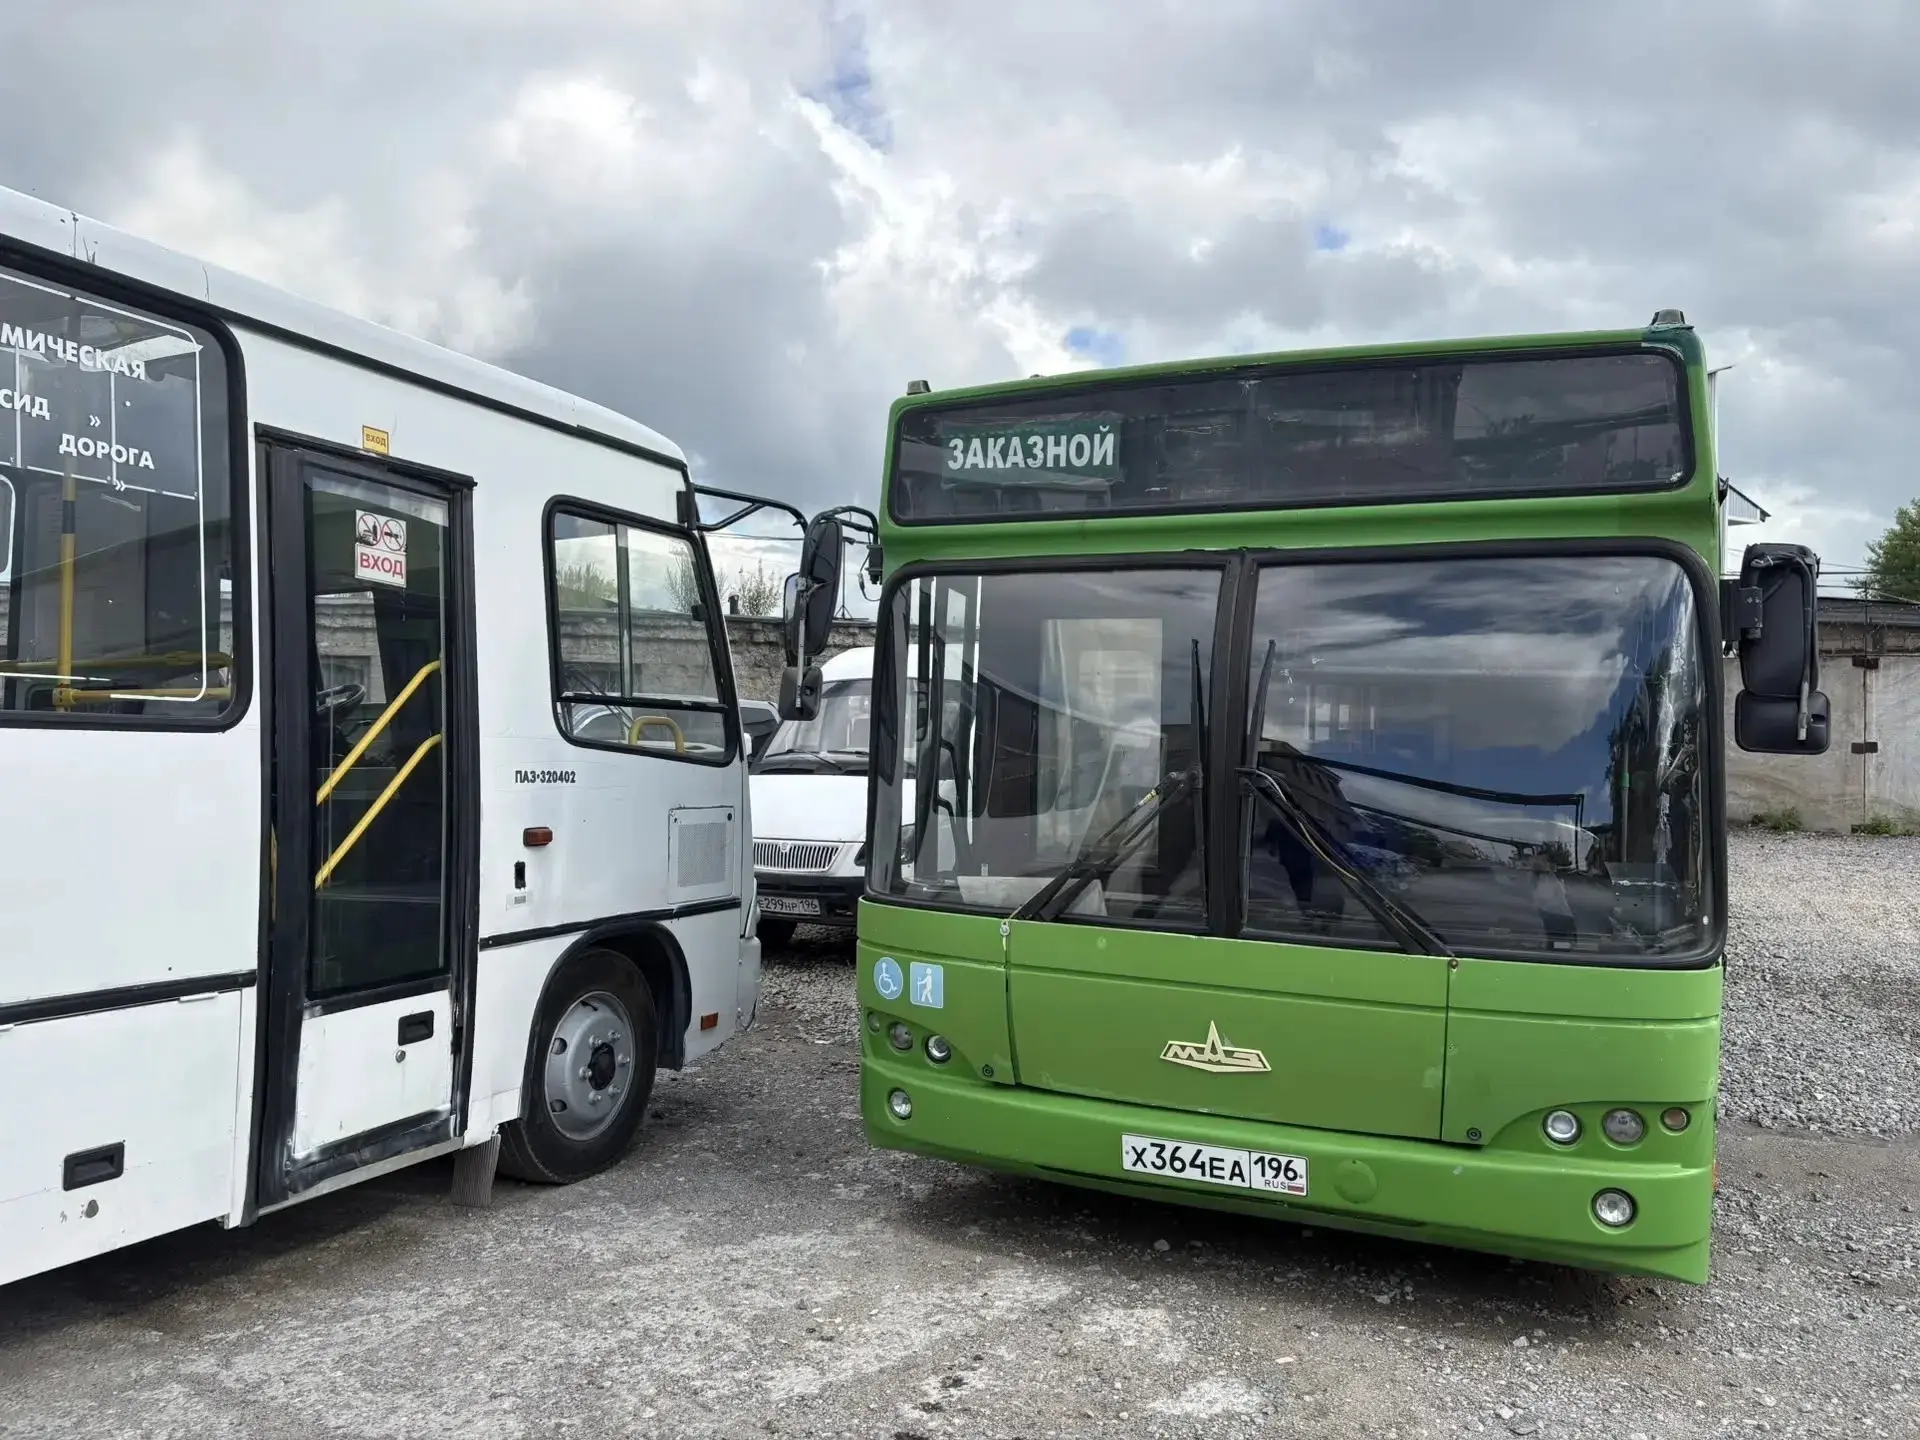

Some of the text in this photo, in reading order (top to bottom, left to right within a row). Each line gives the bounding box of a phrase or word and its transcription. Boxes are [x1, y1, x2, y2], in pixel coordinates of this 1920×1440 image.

[59, 433, 155, 469] ДОРОГА
[365, 433, 387, 447] ВХОД
[947, 425, 1114, 470] ЗАКАЗНОЙ
[360, 552, 404, 578] ВХОД
[799, 900, 817, 910] 196
[1253, 1156, 1298, 1181] 196
[1264, 1179, 1287, 1190] RUS
